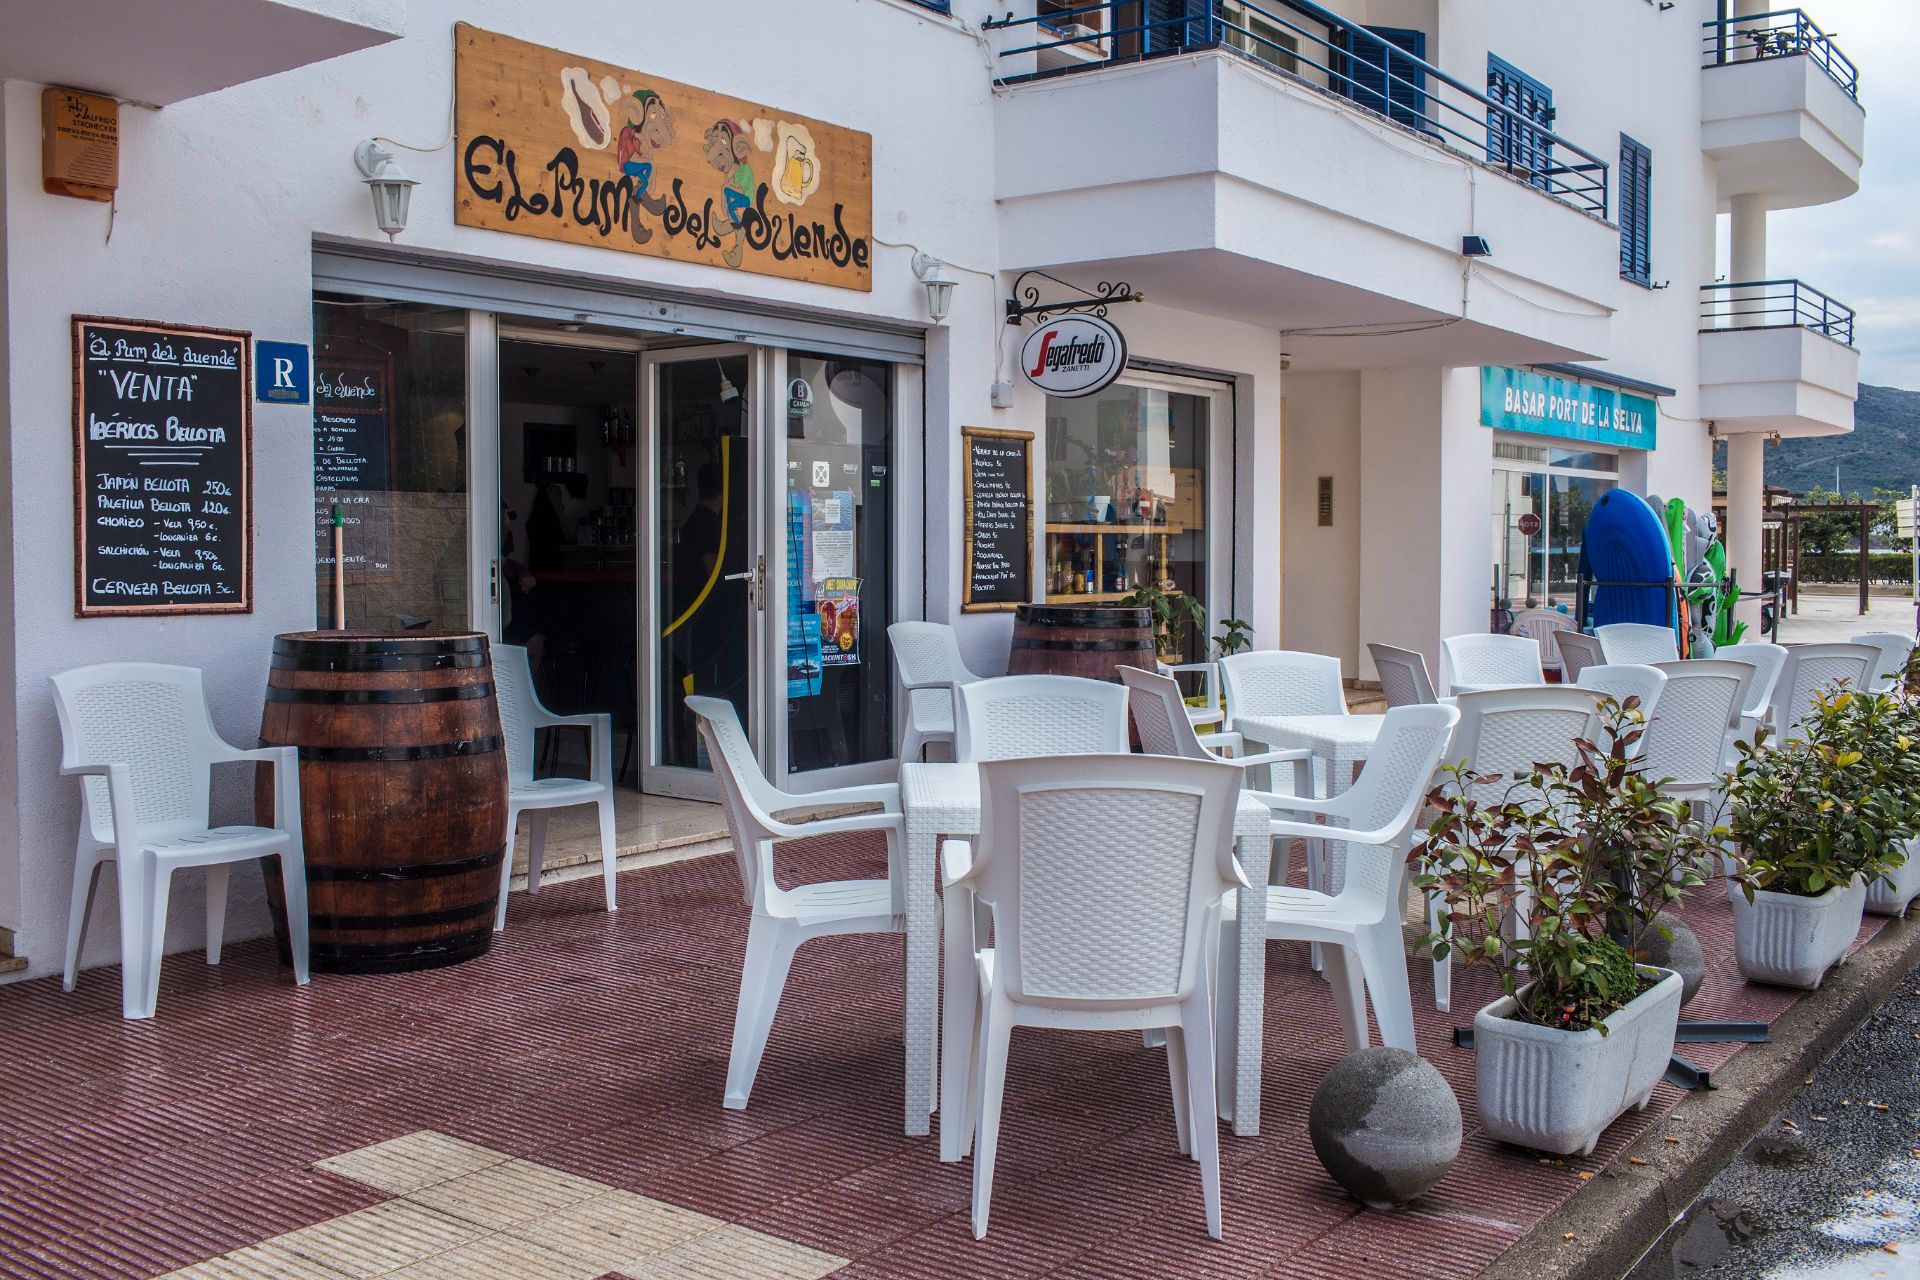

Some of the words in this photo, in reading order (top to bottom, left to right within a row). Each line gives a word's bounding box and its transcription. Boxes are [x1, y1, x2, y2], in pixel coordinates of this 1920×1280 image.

[114, 338, 148, 358] Pum
[151, 343, 177, 361] del
[1030, 330, 1105, 377] Segafredo
[273, 357, 297, 389] R
[1062, 364, 1090, 373] ZANETTI
[98, 369, 199, 403] "VENTA"
[1503, 386, 1546, 419] BASAR
[1549, 395, 1578, 423] PORT
[1581, 401, 1595, 426] DE
[1598, 404, 1610, 428] LA
[1613, 408, 1643, 434] SELVA
[89, 413, 160, 441] IBÉRICOS
[165, 416, 226, 443] BELLOTA
[96, 473, 139, 491] JAMÓN
[144, 477, 190, 493] BELLOTA
[97, 495, 144, 510] PALETILLA
[150, 498, 191, 513] BELLOTA
[97, 514, 145, 528] CHORIZO
[163, 518, 182, 529] VELA
[97, 544, 149, 556] SALCHICHÓN
[92, 578, 159, 596] CERVEZA
[162, 580, 212, 596] BELLOTA
